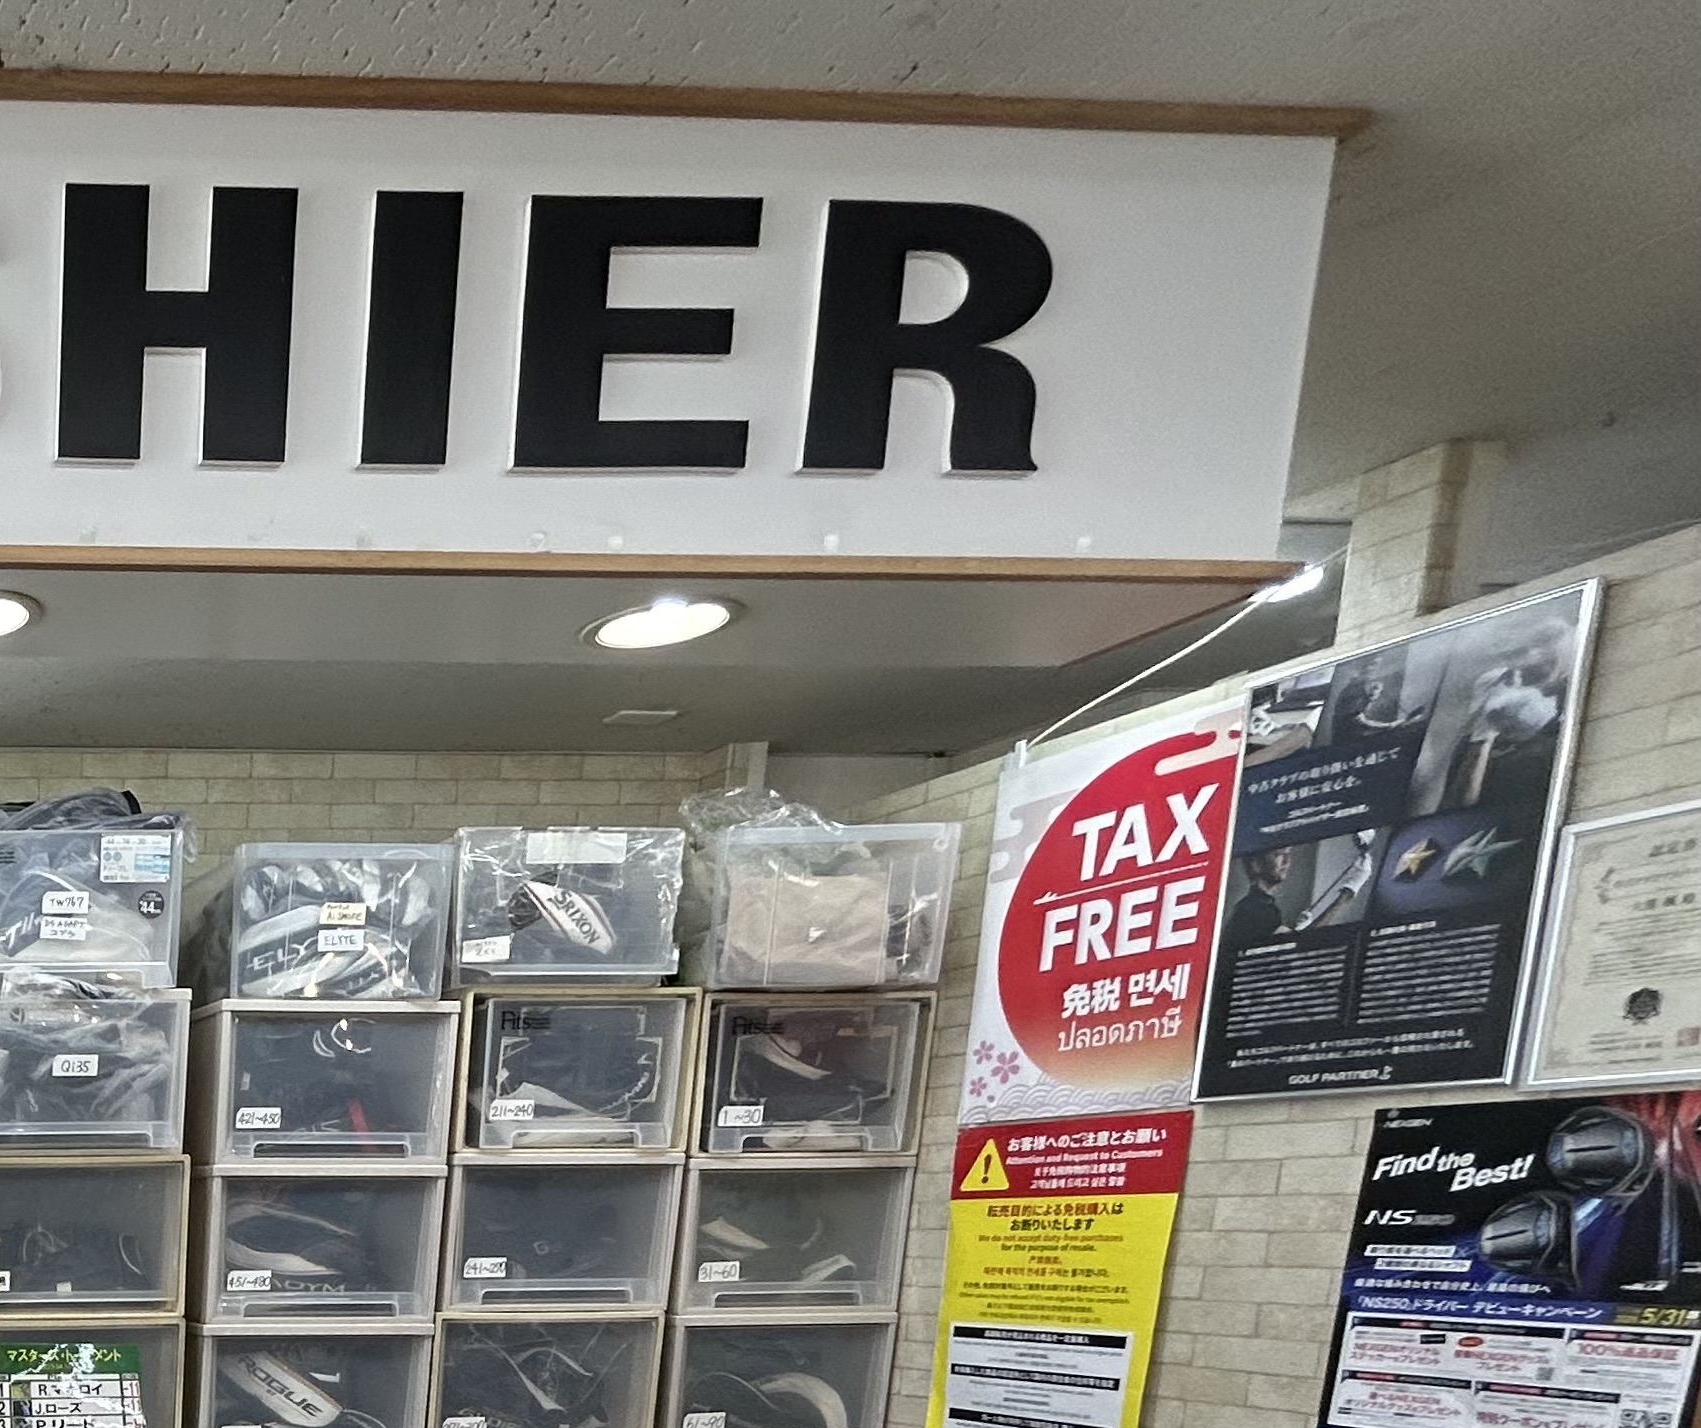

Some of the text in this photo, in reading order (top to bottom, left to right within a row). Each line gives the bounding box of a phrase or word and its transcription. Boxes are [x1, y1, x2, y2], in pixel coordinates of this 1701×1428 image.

[1072, 782, 1219, 881] TAX
[554, 890, 601, 946] SRIXON
[1039, 876, 1206, 972] FREE
[1061, 975, 1121, 1019] 免税
[1128, 962, 1191, 1008] 면세
[1057, 1004, 1182, 1052] ปลอดภาษี
[1288, 1067, 1378, 1086] GOLF PARTNER
[1007, 1127, 1167, 1152] お客様へのご注意とお願い
[1372, 1147, 1475, 1182] Find the
[1450, 1154, 1536, 1193] Best!
[1010, 1218, 1095, 1231] お断りいたします
[237, 1356, 324, 1418] ROGUE
